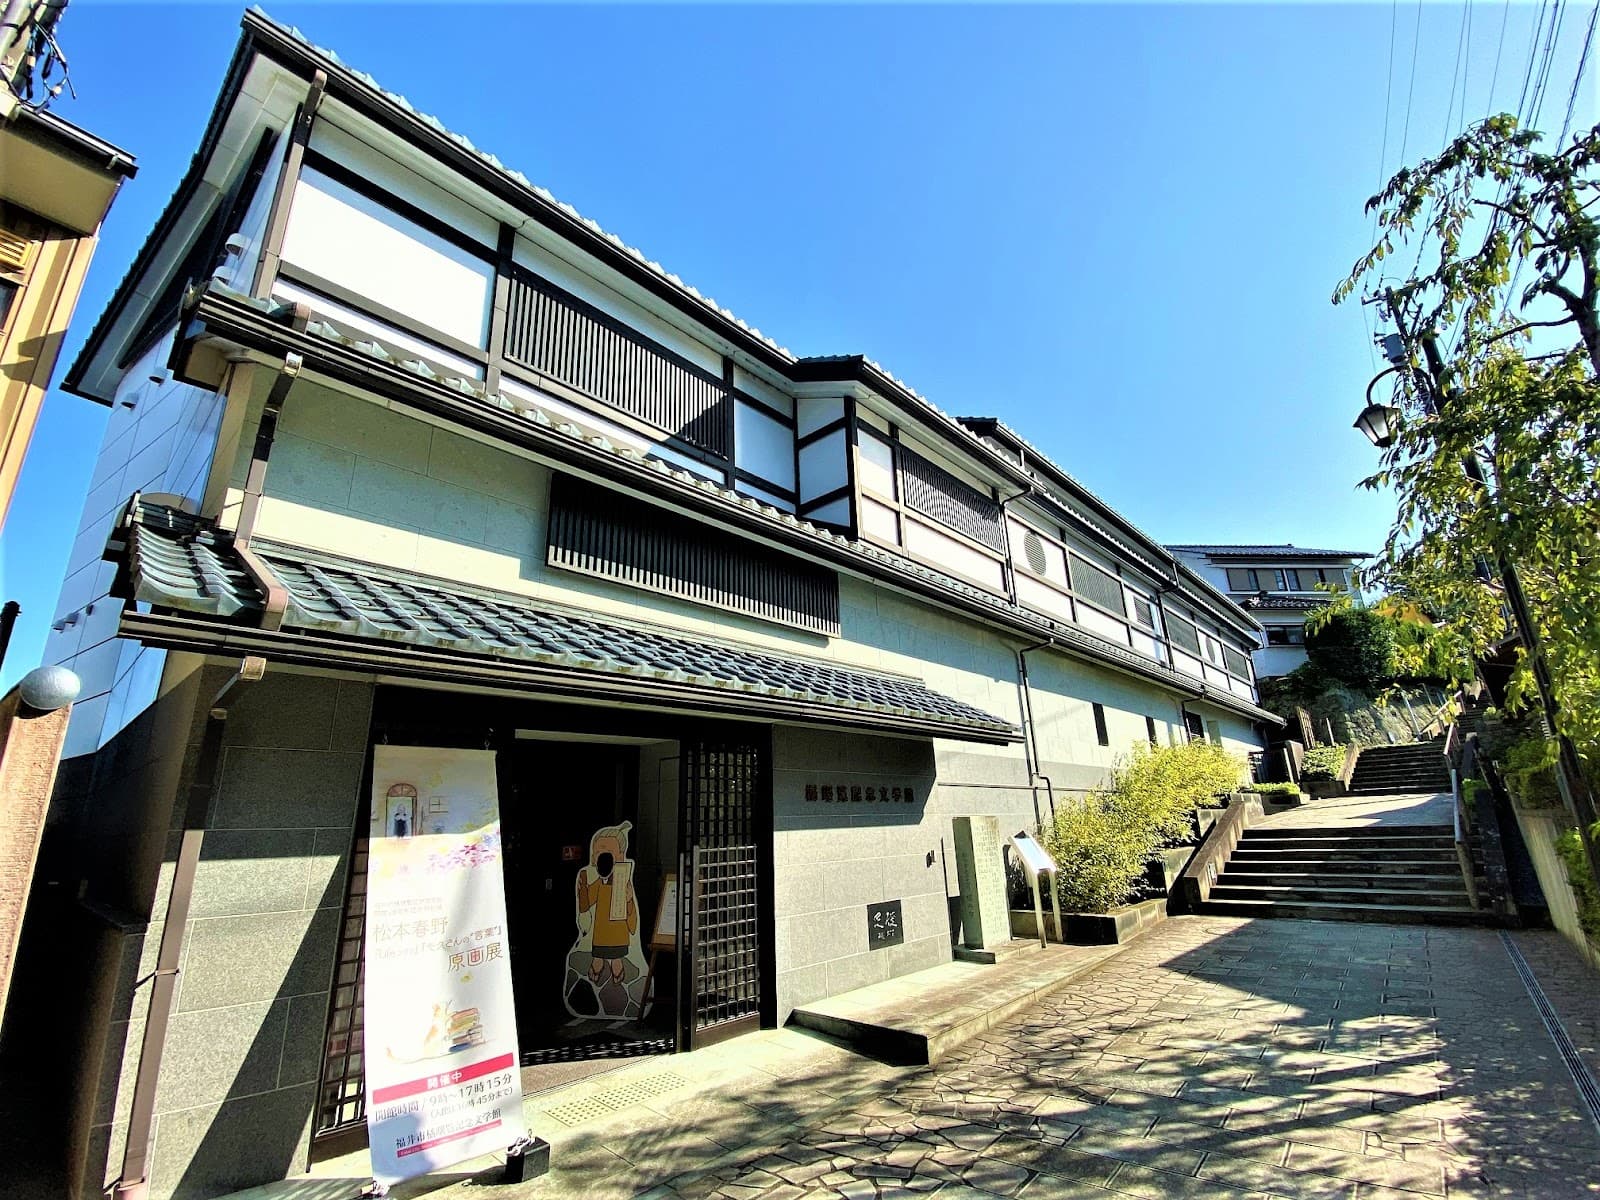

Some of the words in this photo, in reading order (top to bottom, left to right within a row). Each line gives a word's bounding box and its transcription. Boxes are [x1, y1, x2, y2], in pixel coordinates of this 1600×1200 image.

[448, 942, 503, 973] 原画展
[427, 1071, 463, 1090] 開催中
